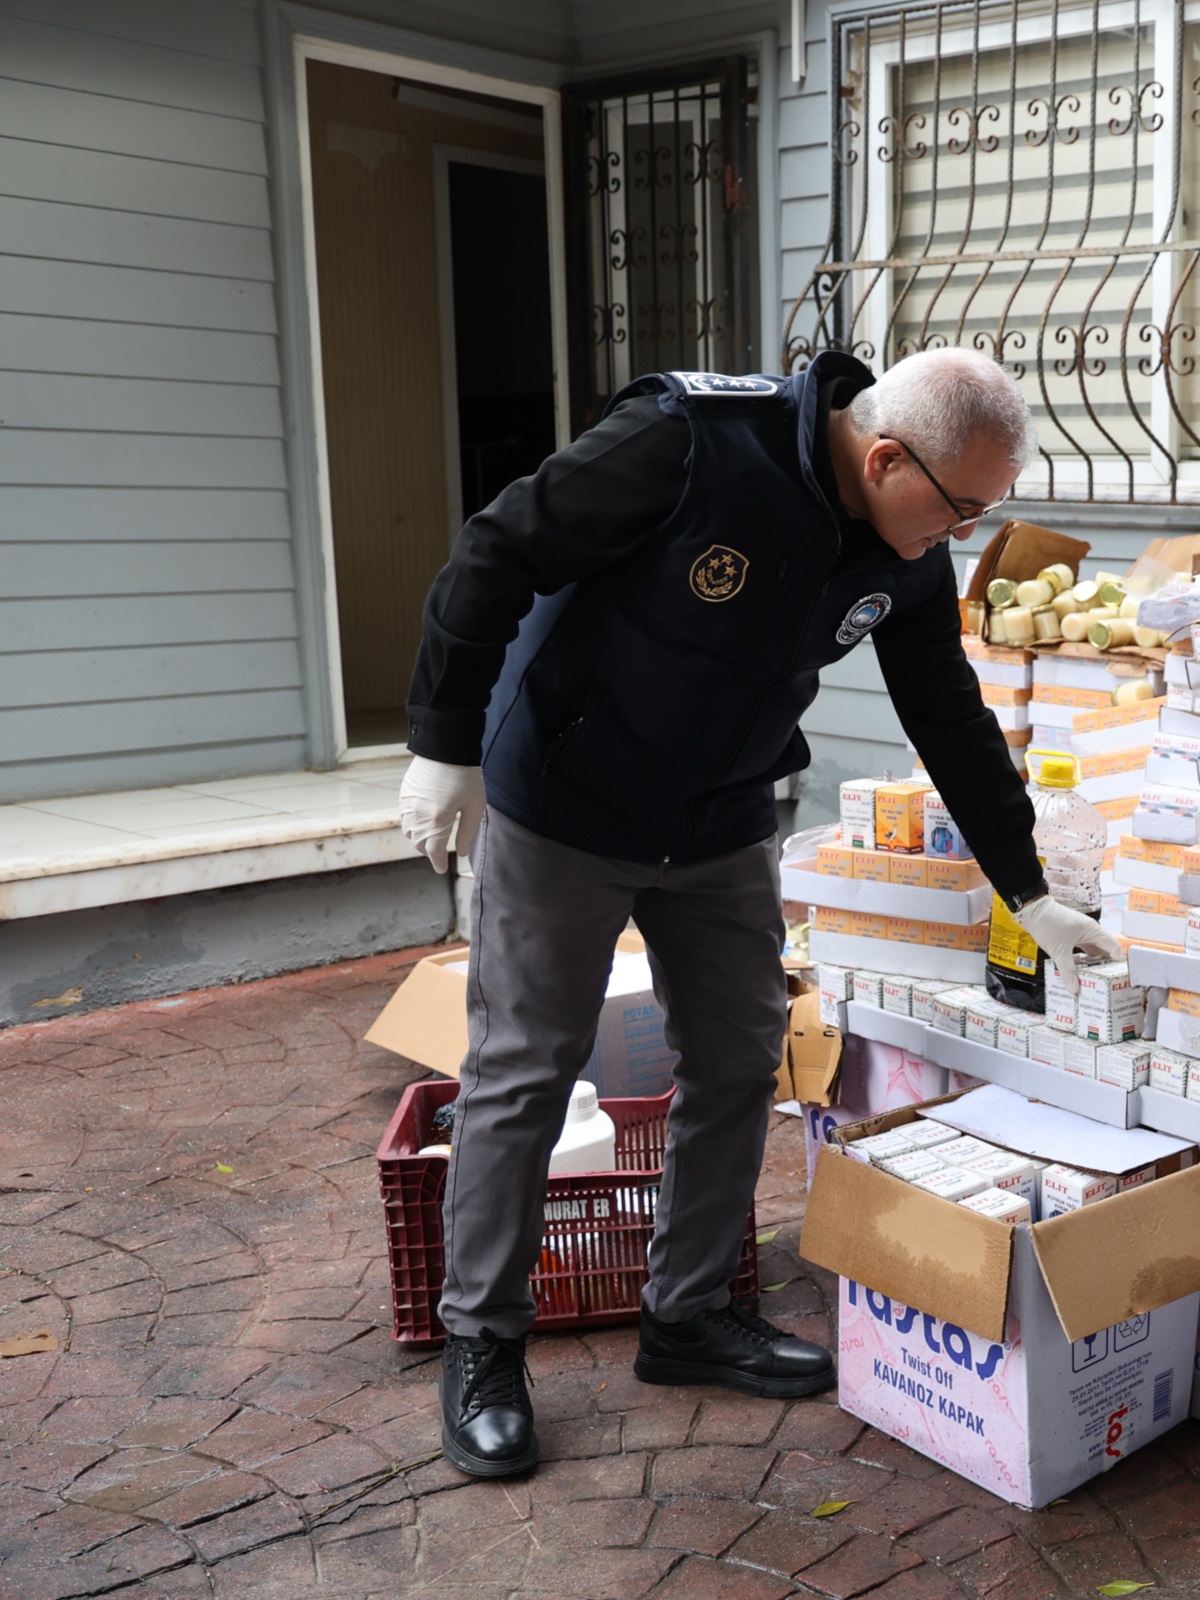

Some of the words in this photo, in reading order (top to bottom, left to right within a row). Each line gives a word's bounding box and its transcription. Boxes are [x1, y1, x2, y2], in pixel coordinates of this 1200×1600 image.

[544, 1200, 587, 1221] MURAT
[593, 1198, 610, 1218] ER
[901, 1347, 932, 1379] Twist
[936, 1369, 953, 1390] Off
[874, 1358, 934, 1409] KAVANOZ
[939, 1395, 985, 1437] KAPAK
